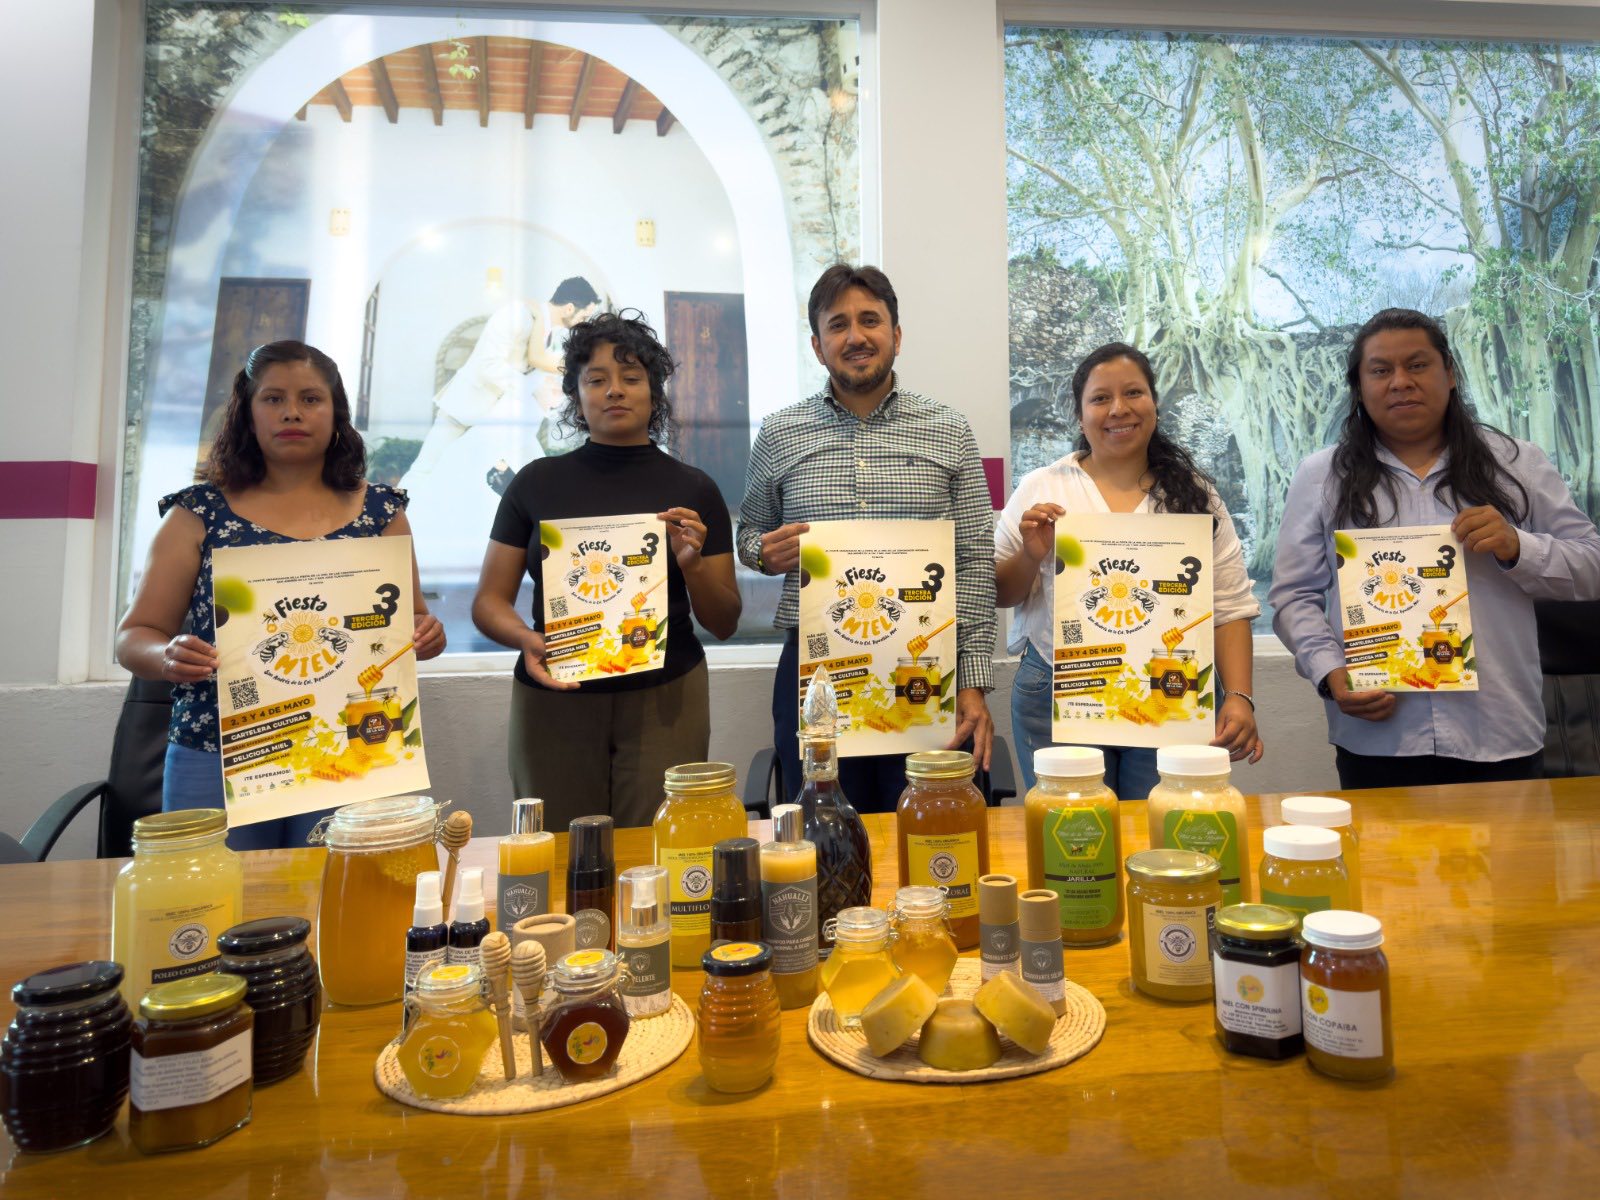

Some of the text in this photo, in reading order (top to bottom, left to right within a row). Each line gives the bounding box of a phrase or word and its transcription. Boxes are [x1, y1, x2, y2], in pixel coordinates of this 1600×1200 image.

[577, 540, 612, 556] Fiesta
[641, 532, 660, 557] 3
[1098, 557, 1140, 575] Fiesta
[1371, 550, 1406, 566] Fiesta
[1436, 544, 1456, 570] 3
[844, 567, 886, 586] Fiesta
[921, 563, 945, 593] 3
[1176, 556, 1202, 586] 3
[578, 578, 618, 599] MIEL
[274, 594, 327, 618] Fiesta
[372, 583, 400, 617] 3
[1374, 589, 1415, 609] MIEL
[351, 614, 385, 623] TERCERA
[351, 619, 386, 629] EDICIÓN
[584, 613, 601, 622] MAYO
[1095, 605, 1146, 628] MIEL
[842, 615, 893, 639] MIEL
[1101, 646, 1122, 654] MAYO
[274, 648, 337, 677] MIEL
[847, 656, 869, 666] MAYO
[838, 670, 866, 679] CULTURAL
[1060, 681, 1089, 689] DELICIOSA
[268, 706, 281, 715] DE
[283, 698, 311, 711] MAYO
[231, 714, 308, 740] CARTELERA CULTURAL
[233, 742, 289, 763] DELICIOSA MIEL
[772, 893, 809, 905] NAHUALLI
[179, 966, 197, 977] CON
[1234, 1002, 1250, 1011] CON
[1251, 1004, 1283, 1015] SPIRULINA
[1319, 1017, 1358, 1032] COPAIBA
